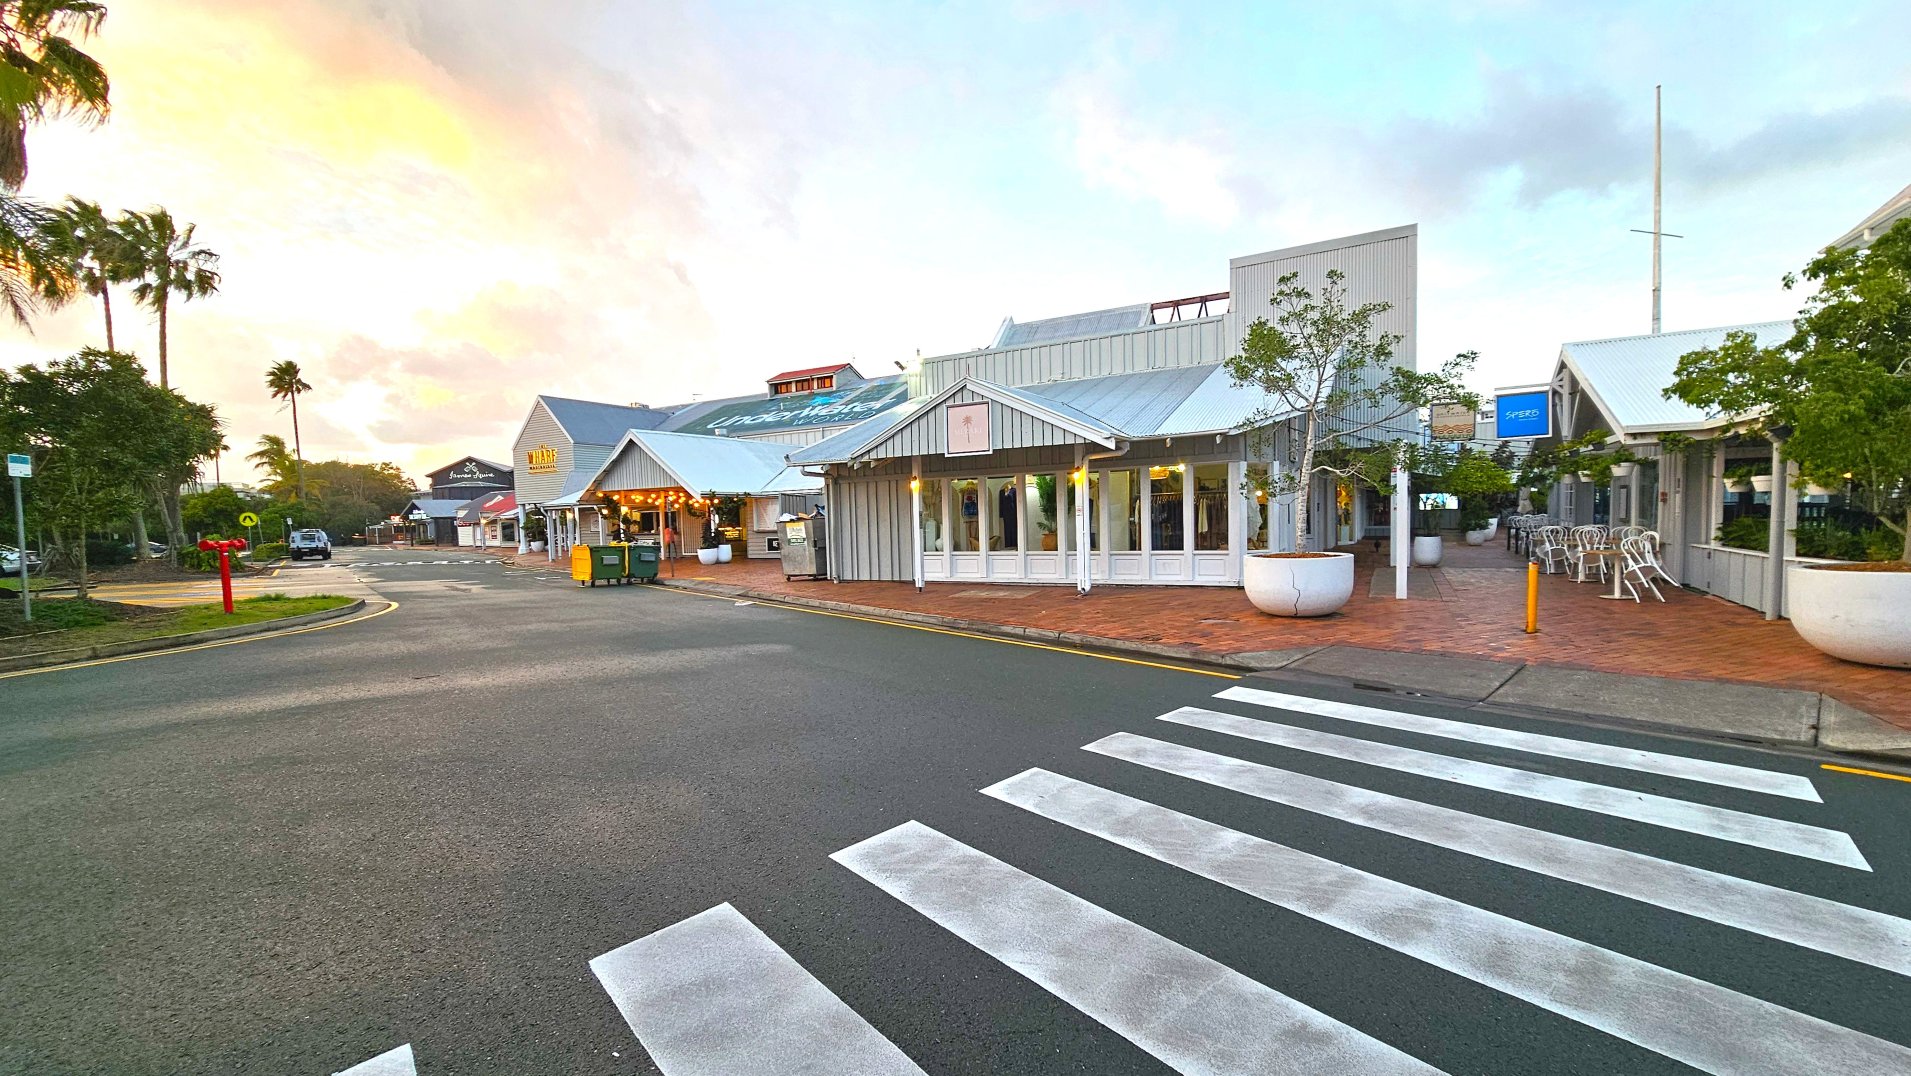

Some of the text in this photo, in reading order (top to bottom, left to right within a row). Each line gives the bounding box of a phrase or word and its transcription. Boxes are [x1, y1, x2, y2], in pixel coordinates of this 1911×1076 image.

[793, 410, 877, 426] WORLD
[527, 447, 558, 466] WHARF
[449, 470, 472, 480] James
